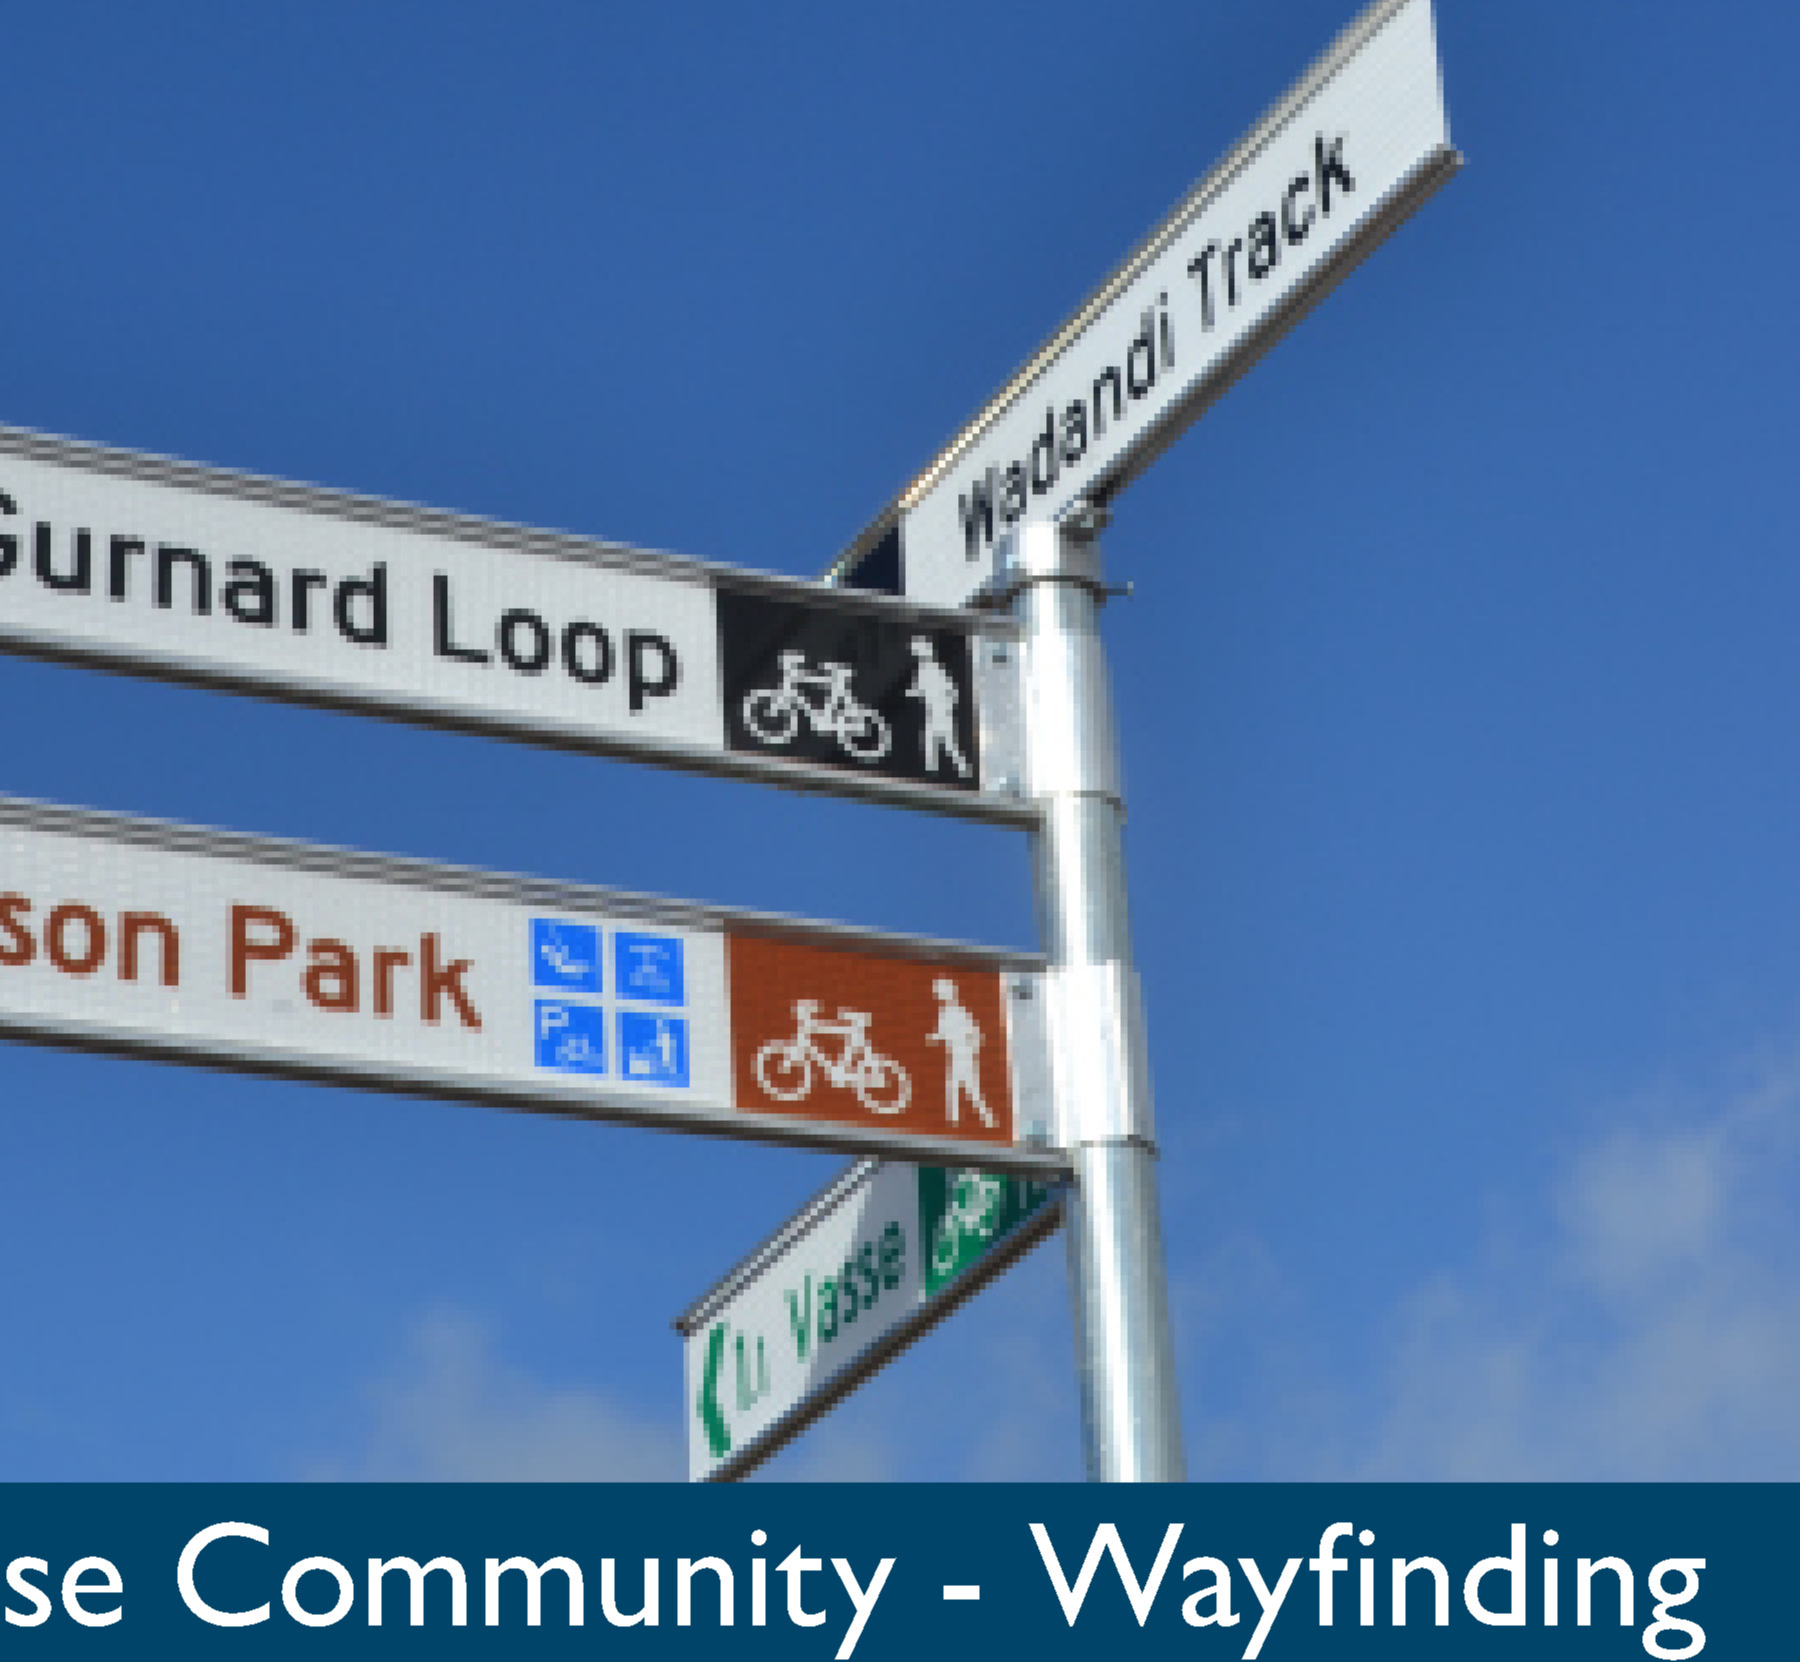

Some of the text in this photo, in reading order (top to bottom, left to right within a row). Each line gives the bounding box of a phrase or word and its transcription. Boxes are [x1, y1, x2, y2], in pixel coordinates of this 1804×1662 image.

[958, 131, 1357, 563] Wadandi Track
[431, 573, 679, 712] Loop
[230, 903, 484, 1030] Park
[786, 1221, 906, 1363] Vasse
